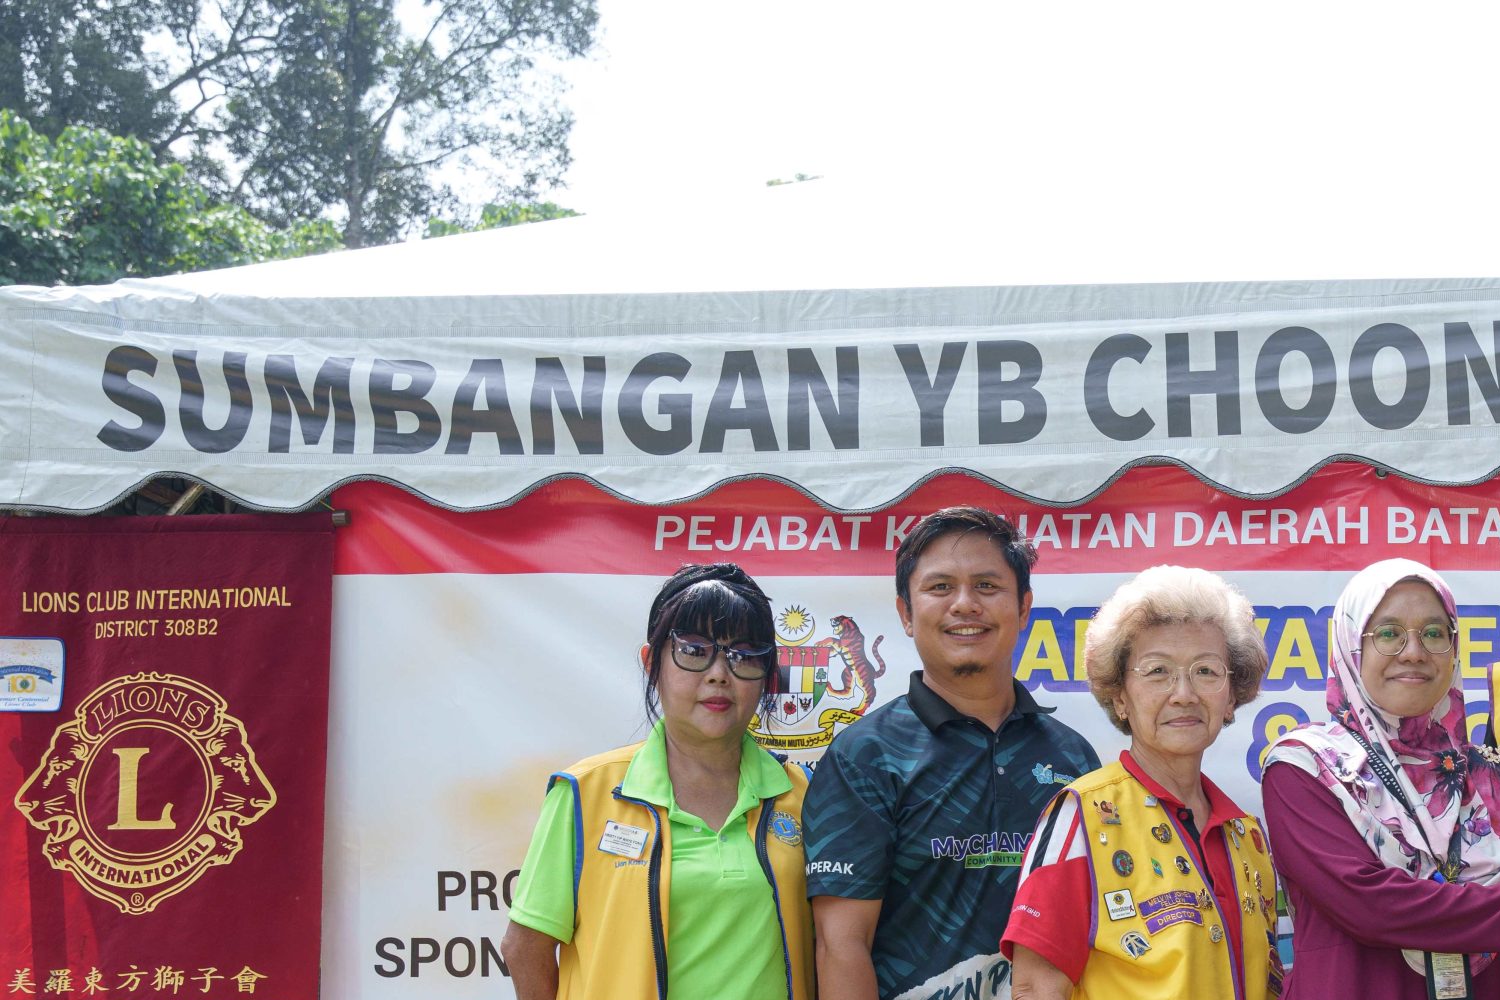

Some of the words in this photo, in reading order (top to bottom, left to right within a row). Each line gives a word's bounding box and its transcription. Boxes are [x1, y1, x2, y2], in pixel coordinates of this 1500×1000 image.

[97, 345, 859, 456] SUMBANGAN
[894, 339, 1047, 448] YB
[654, 515, 872, 552] PEJABAT
[885, 512, 1156, 551] KATAN
[1173, 507, 1369, 547] DAERAH
[22, 591, 80, 613] LIONS
[86, 589, 129, 613] CLUB
[135, 586, 291, 610] INTERNATIONAL
[95, 619, 159, 640] DISTRICT
[92, 686, 210, 730] LIONS
[107, 747, 177, 830] L
[75, 839, 209, 885] INTERNATIONAL
[810, 860, 854, 876] PERAK
[966, 855, 1017, 866] COMMUNITY
[7, 965, 268, 995] 美羅東方獅子會
